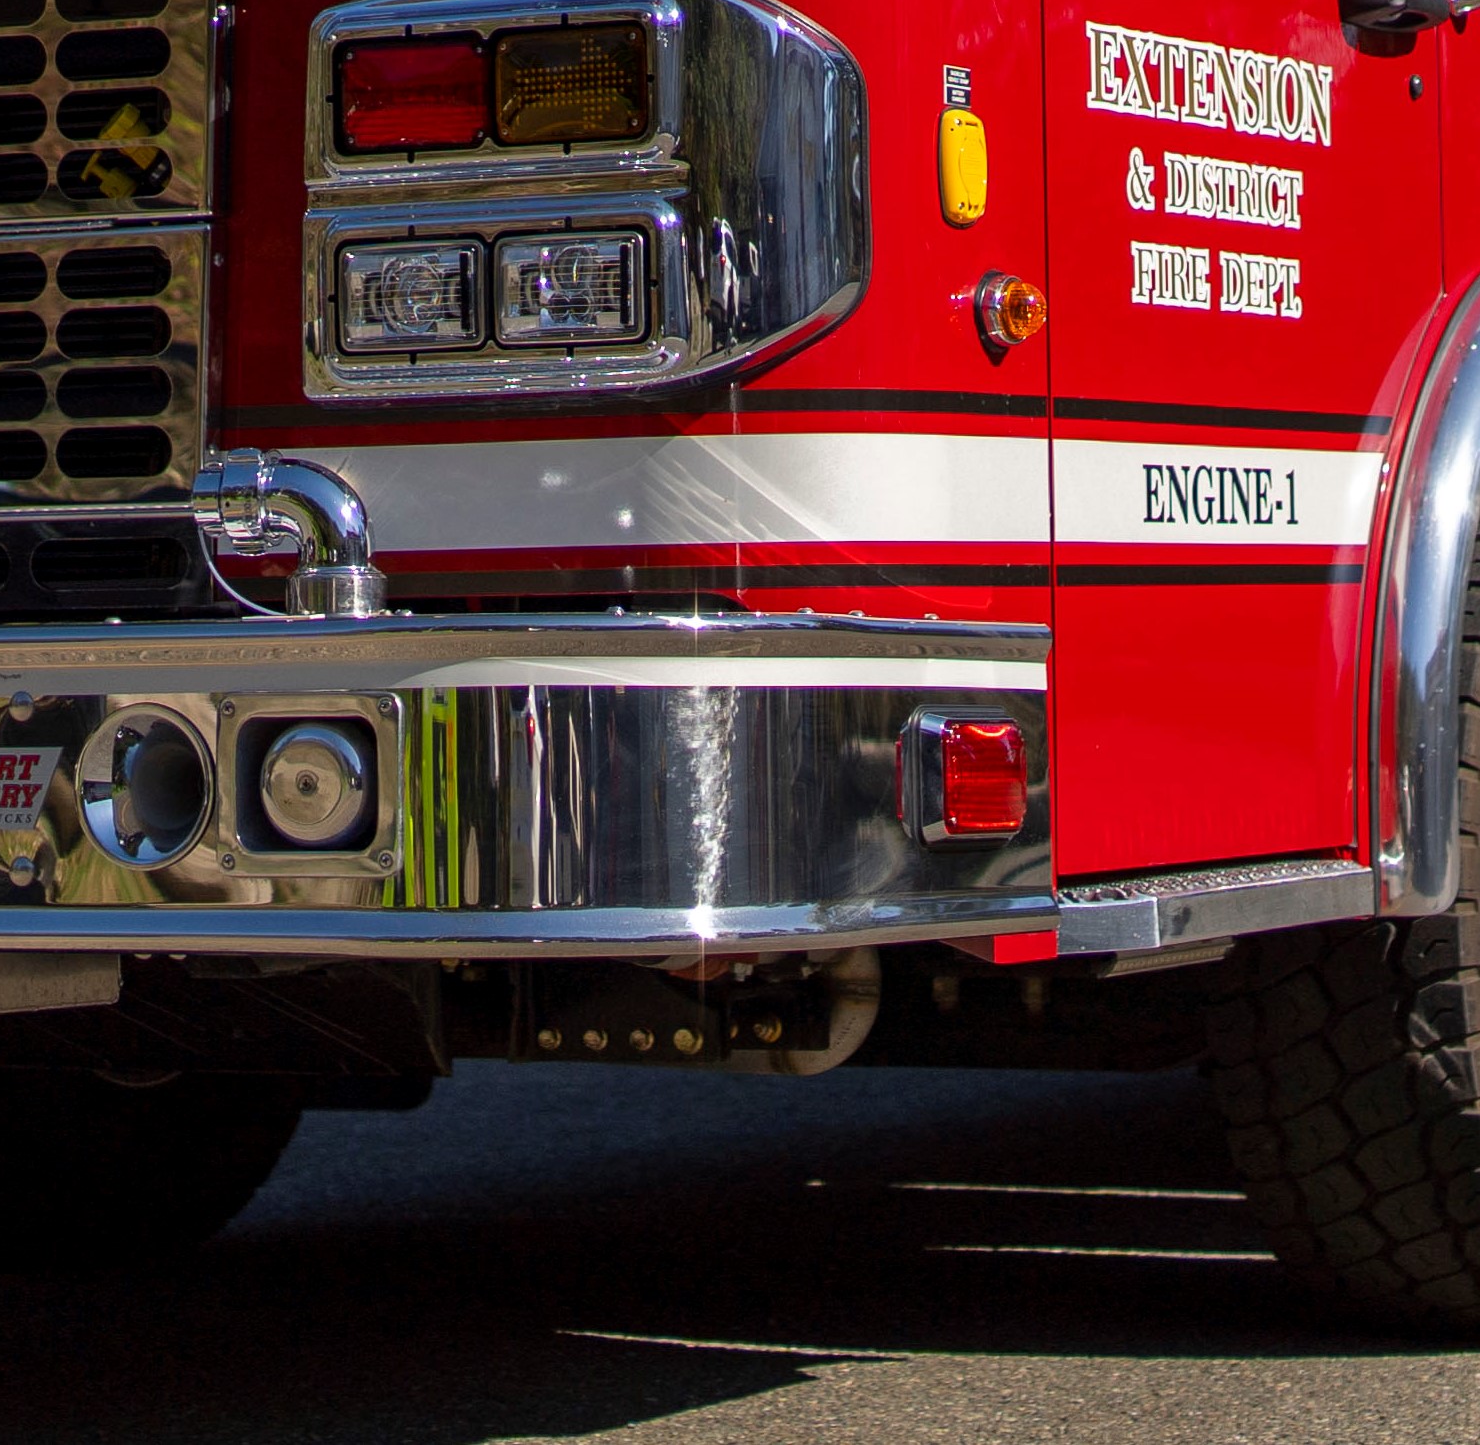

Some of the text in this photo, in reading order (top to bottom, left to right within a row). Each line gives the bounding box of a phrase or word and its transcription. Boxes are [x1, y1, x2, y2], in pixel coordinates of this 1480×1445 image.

[1086, 21, 1332, 146] EXTENSION
[1127, 147, 1303, 229] & DISTRICT
[1131, 241, 1303, 319] FIRE DEPT.
[1142, 464, 1299, 525] ENGINE-1
